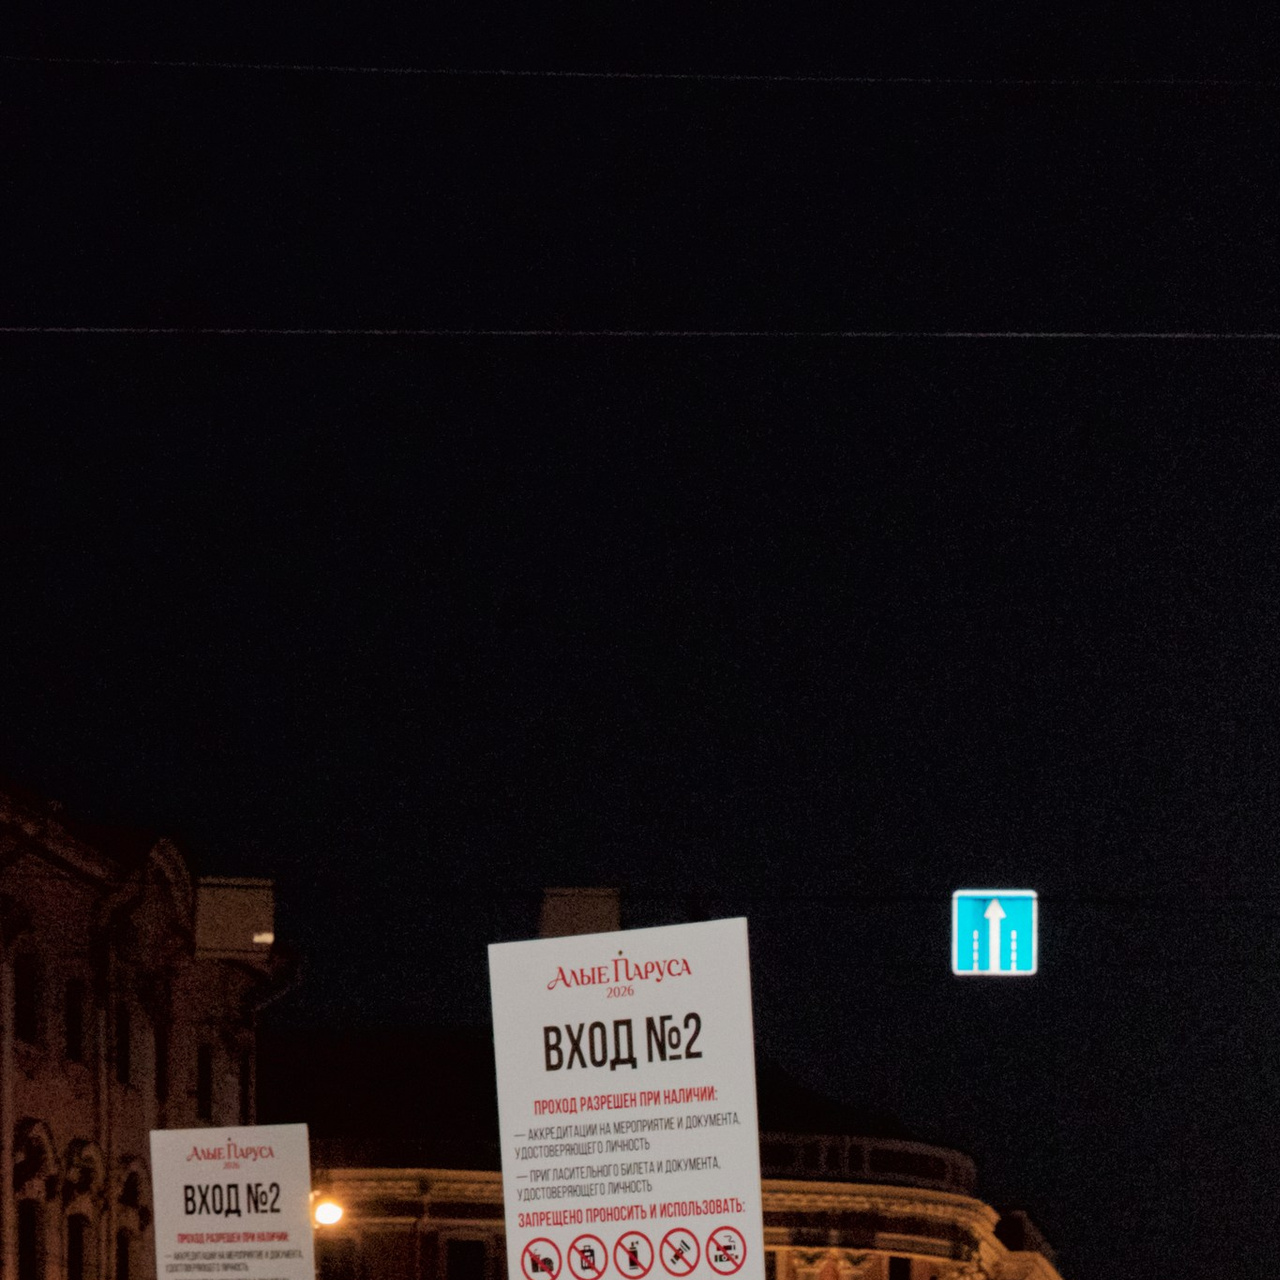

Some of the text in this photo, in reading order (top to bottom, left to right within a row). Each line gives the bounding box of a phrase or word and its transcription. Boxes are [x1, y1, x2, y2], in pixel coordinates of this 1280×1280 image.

[607, 985, 634, 998] 2026
[543, 1012, 703, 1071] ВХОД №2
[534, 1086, 717, 1115] ПРОХОД РАЗРЕШЕН ПРИ НАЛИЧИИ:
[529, 1124, 597, 1140] АККРЕДИТАЦИИ
[600, 1123, 611, 1135] НА
[614, 1117, 674, 1134] МЕРОПРИЯТИЕ
[677, 1117, 683, 1128] И
[686, 1112, 739, 1129] ДОКУМЕНТА,
[515, 1138, 650, 1160] УДОСТОВЕРЯЮЩЕГО ЛИЧНОСТЬ
[530, 1164, 618, 1182] ПРИГЛАСИТЕЛЬНОГО
[621, 1162, 654, 1176] БИЛЕТА
[657, 1161, 663, 1172] И
[665, 1156, 720, 1173] ДОКУМЕНТА,
[184, 1183, 280, 1217] ВХОД №2
[517, 1180, 652, 1201] УДОСТОВЕРЯЮЩЕГО ЛИЧНОСТЬ
[518, 1198, 745, 1228] ЗАПРЕЩЕНО ПРОНОСИТЬ И ИСПОЛЬЗОВАТЬ:
